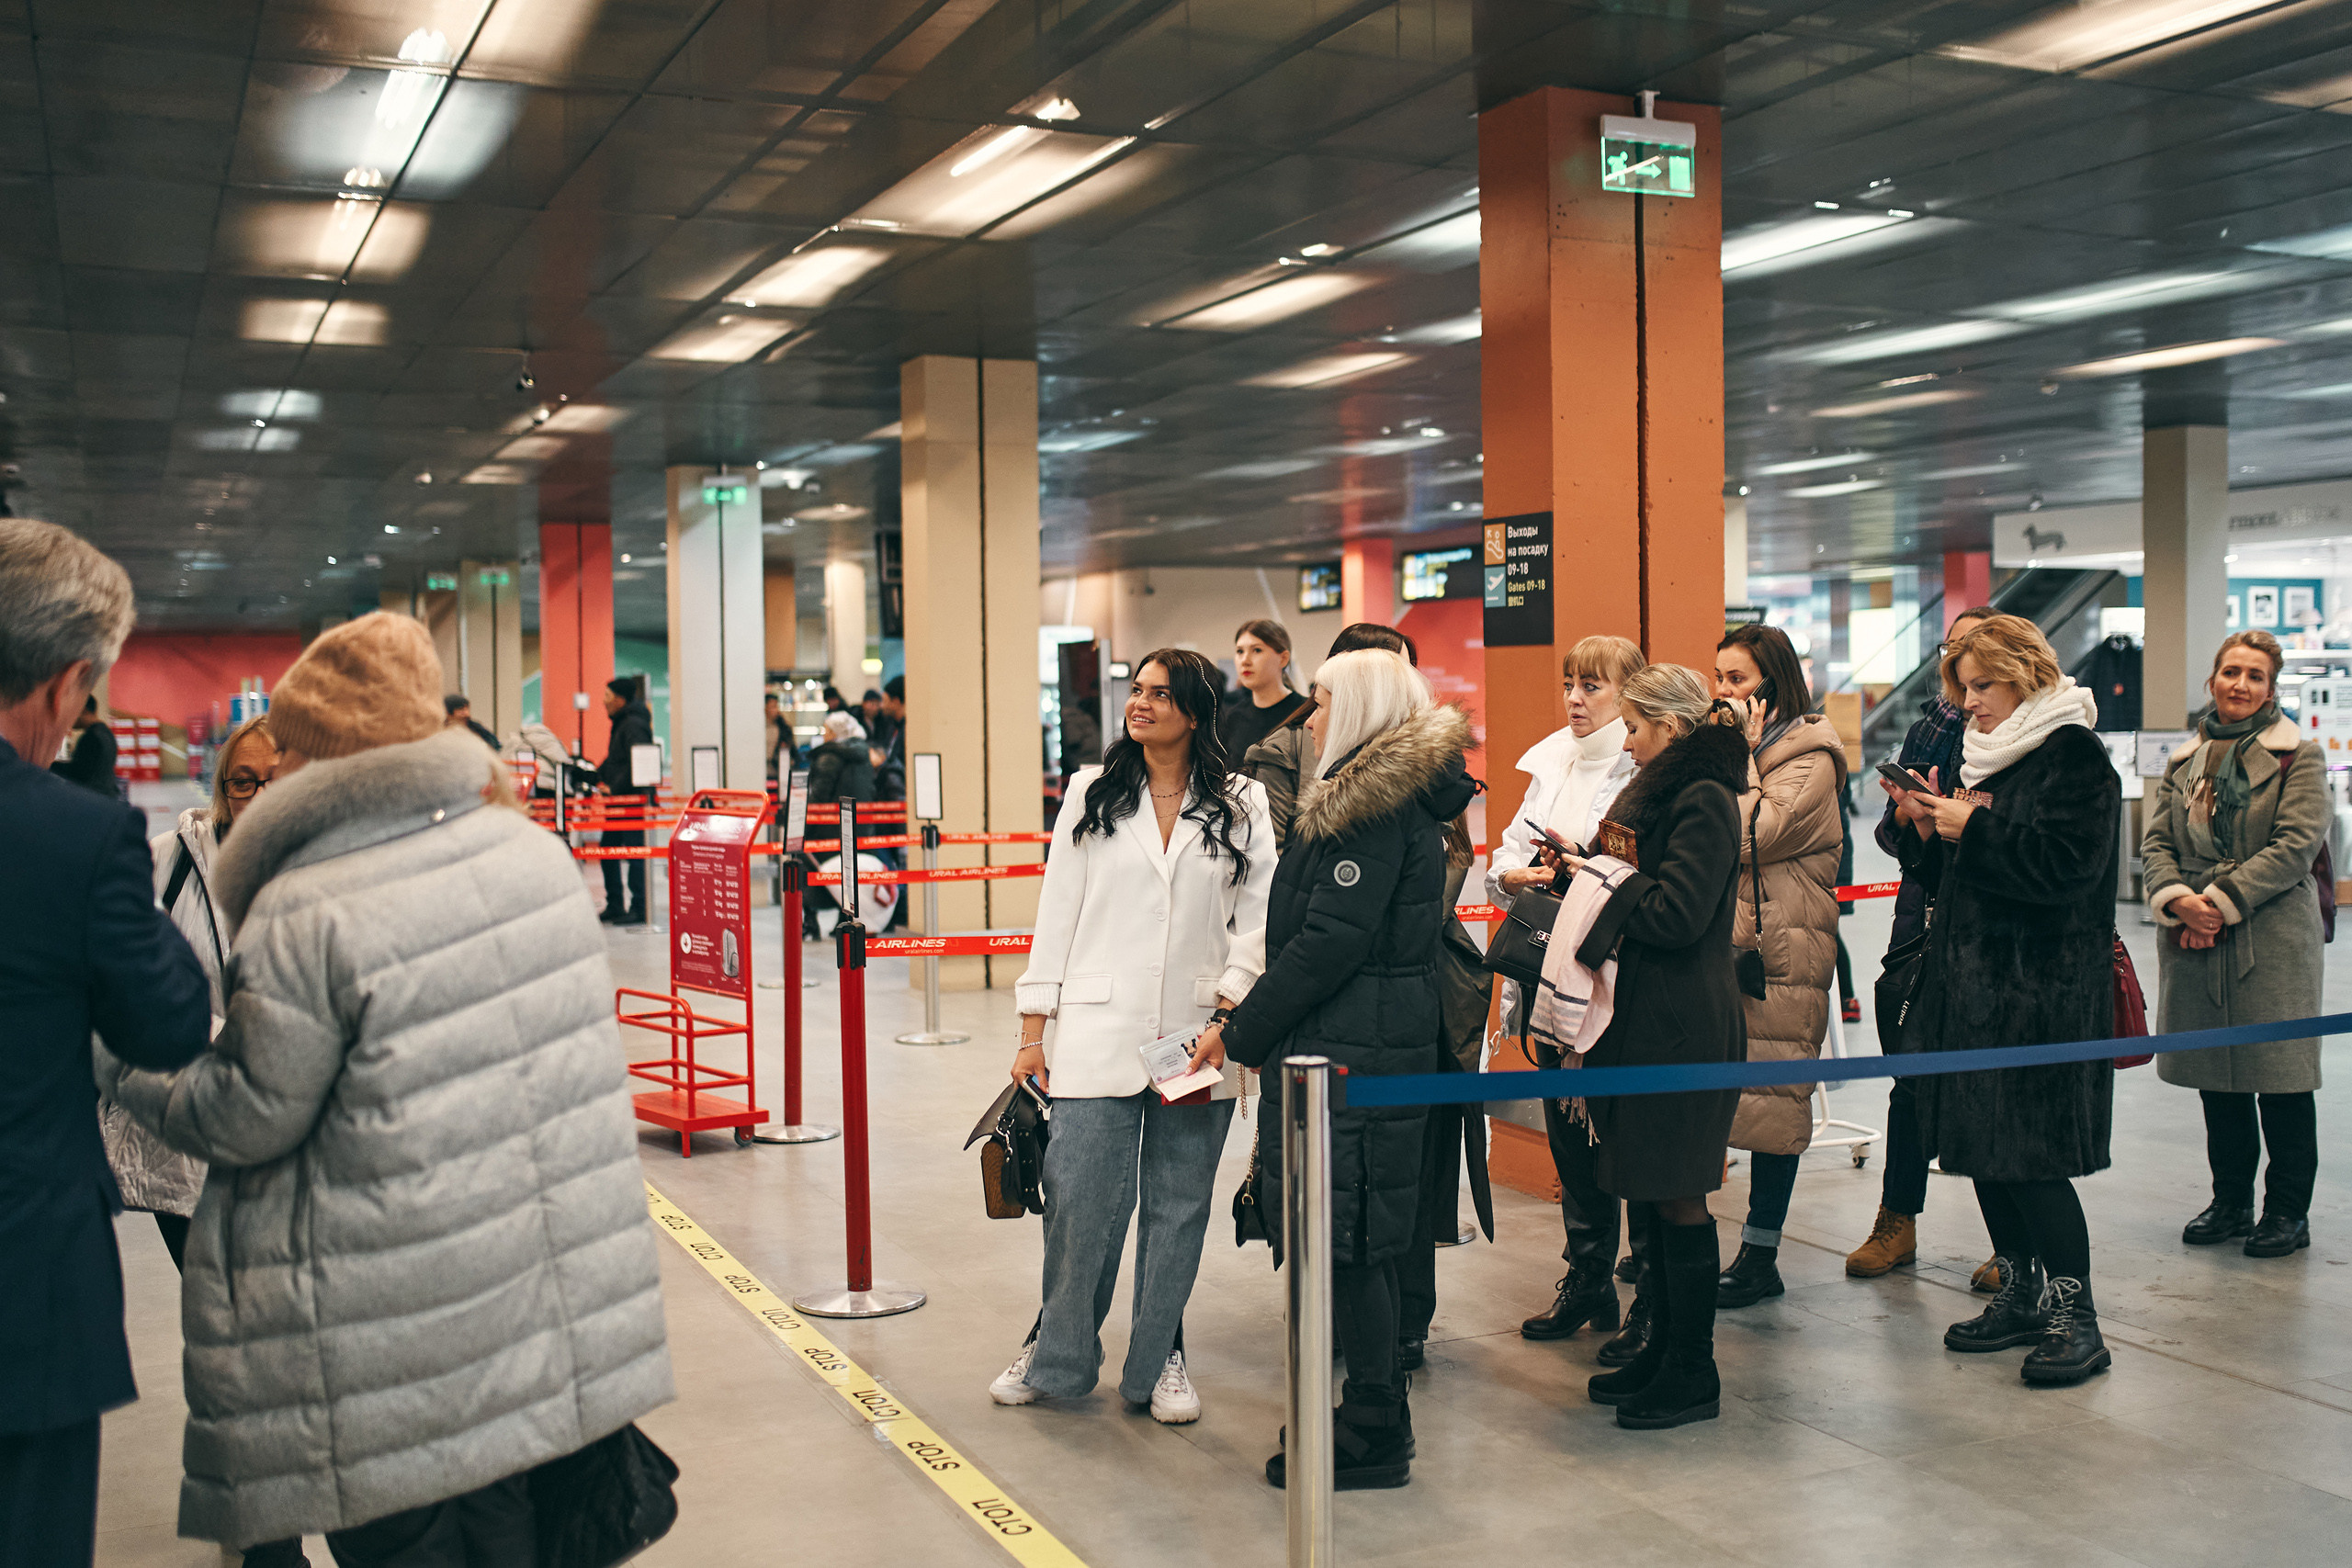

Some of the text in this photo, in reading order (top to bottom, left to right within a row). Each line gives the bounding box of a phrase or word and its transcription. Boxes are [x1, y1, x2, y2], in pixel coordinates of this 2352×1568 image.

[1508, 525, 1538, 538] Выходы
[1508, 545, 1549, 558] на посадку
[1508, 562, 1529, 576] 09-18
[1508, 580, 1545, 592] Gates 09-18
[946, 831, 1010, 840] URAL AIRLINES
[607, 846, 652, 855] AIRLINES
[816, 872, 899, 881] URA IRLINES
[929, 866, 1008, 877] URAL AIRLINES
[1867, 883, 1896, 893] URAL
[1454, 906, 1495, 915] RLINES
[875, 938, 947, 949] AIRLINES
[989, 936, 1030, 947] URAL
[661, 1214, 1033, 1536] СТОП STOP СТОП STOP СТОП STOP СТОП STOP
